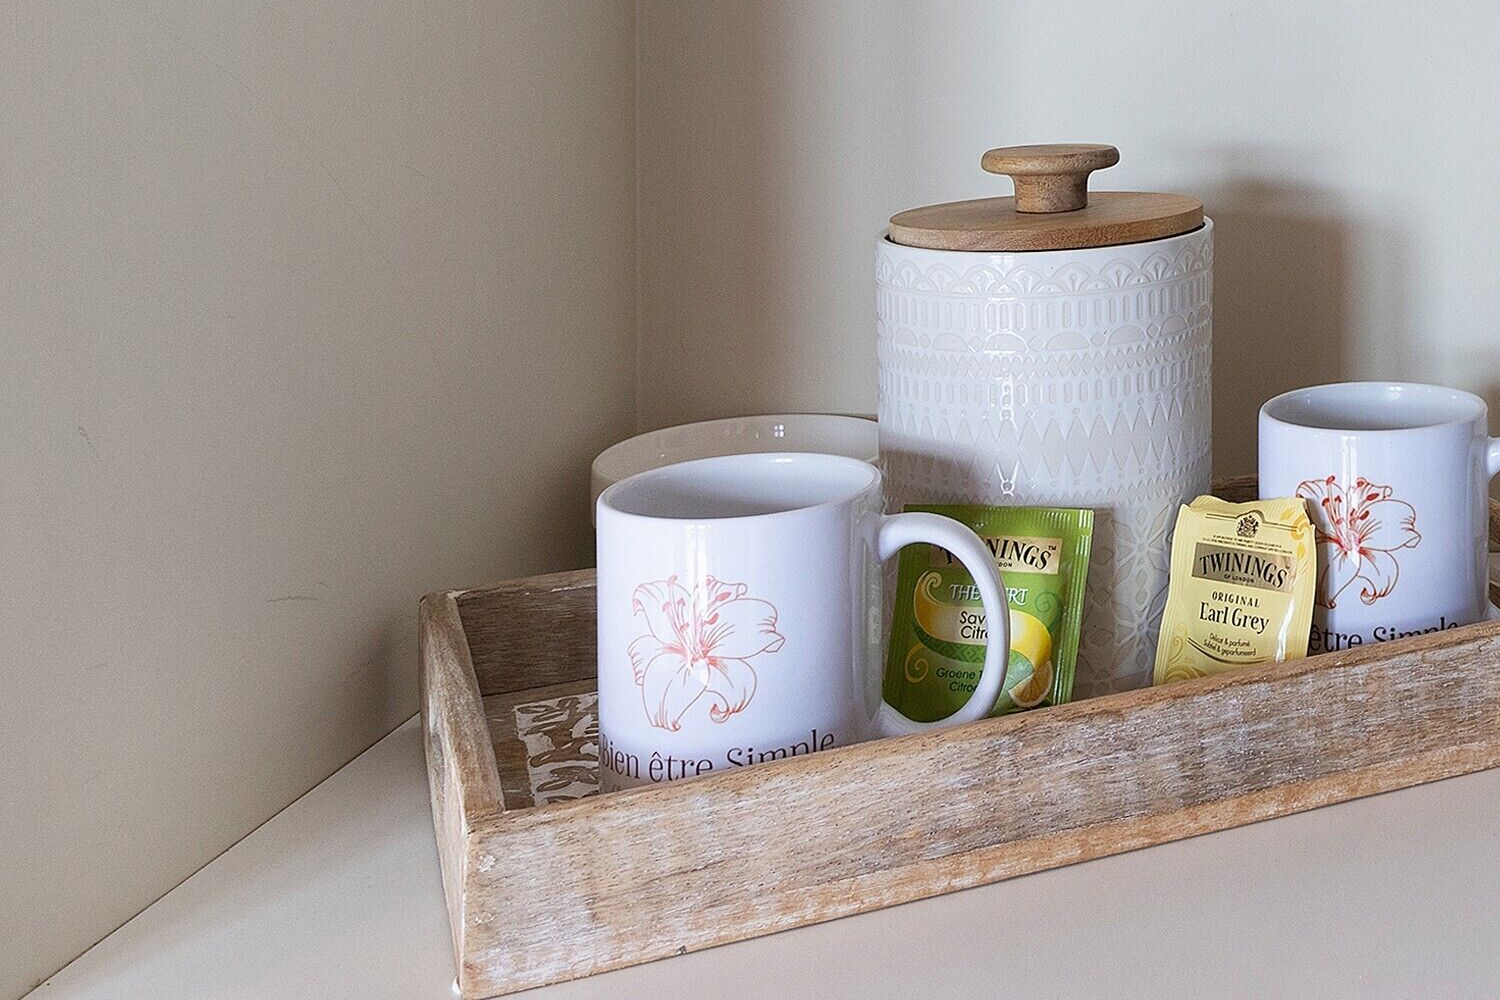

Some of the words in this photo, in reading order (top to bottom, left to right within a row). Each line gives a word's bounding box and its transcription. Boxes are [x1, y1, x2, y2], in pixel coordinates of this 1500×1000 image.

[939, 537, 1051, 571] TNINGS
[1199, 552, 1288, 588] TWININGS
[1231, 575, 1255, 584] LONDON
[1211, 591, 1261, 608] ORIGINAL
[959, 610, 987, 625] Sav
[1199, 601, 1229, 625] Earl
[1231, 607, 1270, 635] Grey
[960, 625, 989, 640] Citr
[1309, 624, 1363, 653] être
[936, 667, 976, 680] Groene
[949, 681, 978, 693] Citro
[601, 733, 641, 780] Bien
[649, 751, 713, 783] être
